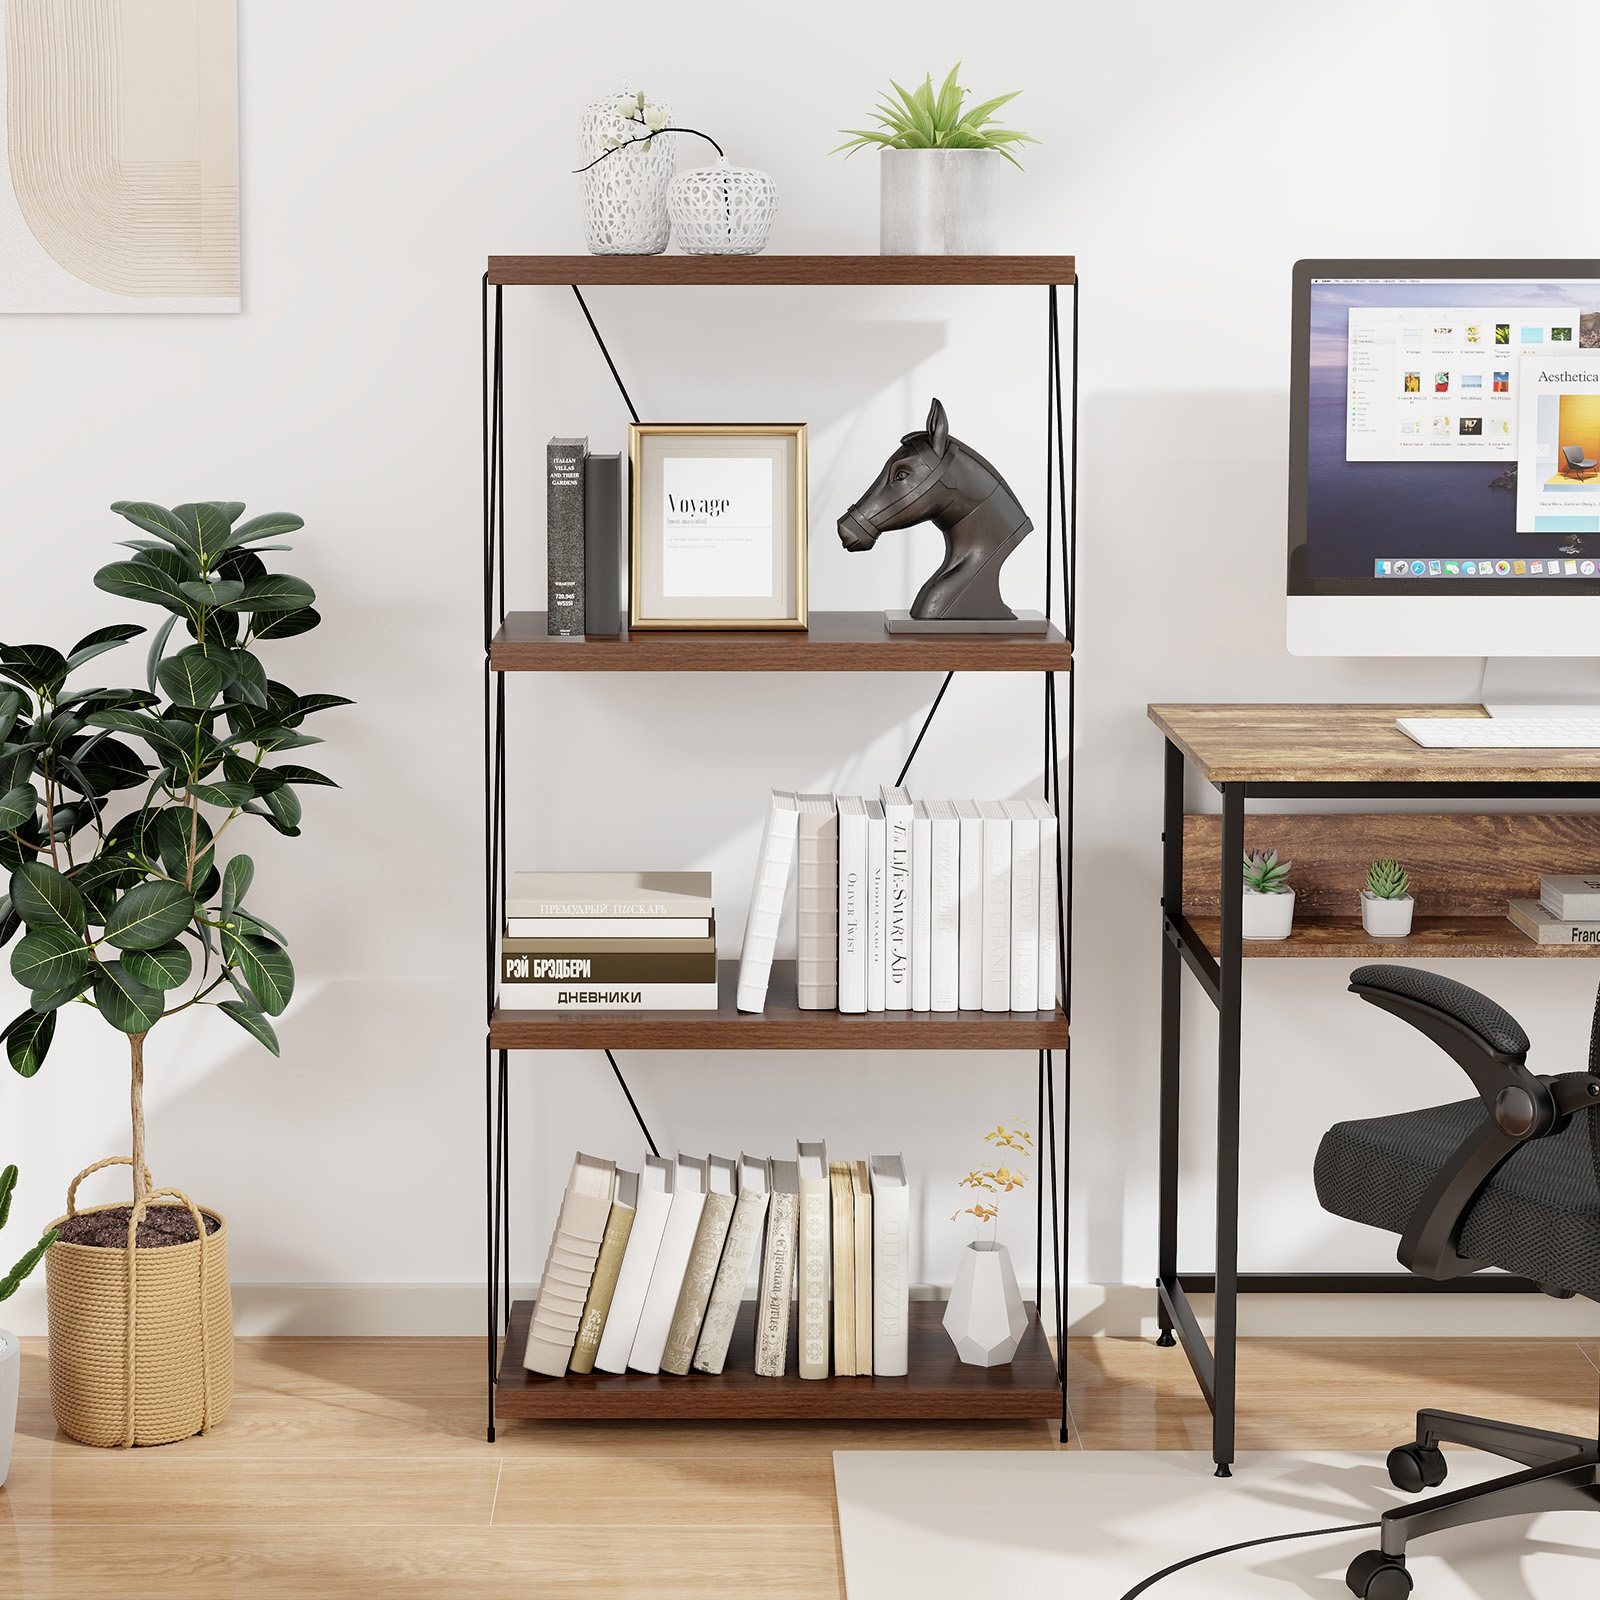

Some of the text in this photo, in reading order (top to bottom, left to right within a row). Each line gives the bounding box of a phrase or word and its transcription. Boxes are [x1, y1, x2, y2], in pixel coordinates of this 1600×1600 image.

[1537, 370, 1599, 382] Aesthetica
[668, 493, 730, 518] Voyage
[540, 903, 667, 915] ПРЕМУДРЫЙ ПИСКАРЬ
[506, 955, 591, 980] РЭЙ БРЭДБЕРИ
[557, 991, 642, 1004] ДНЕВНИКИ
